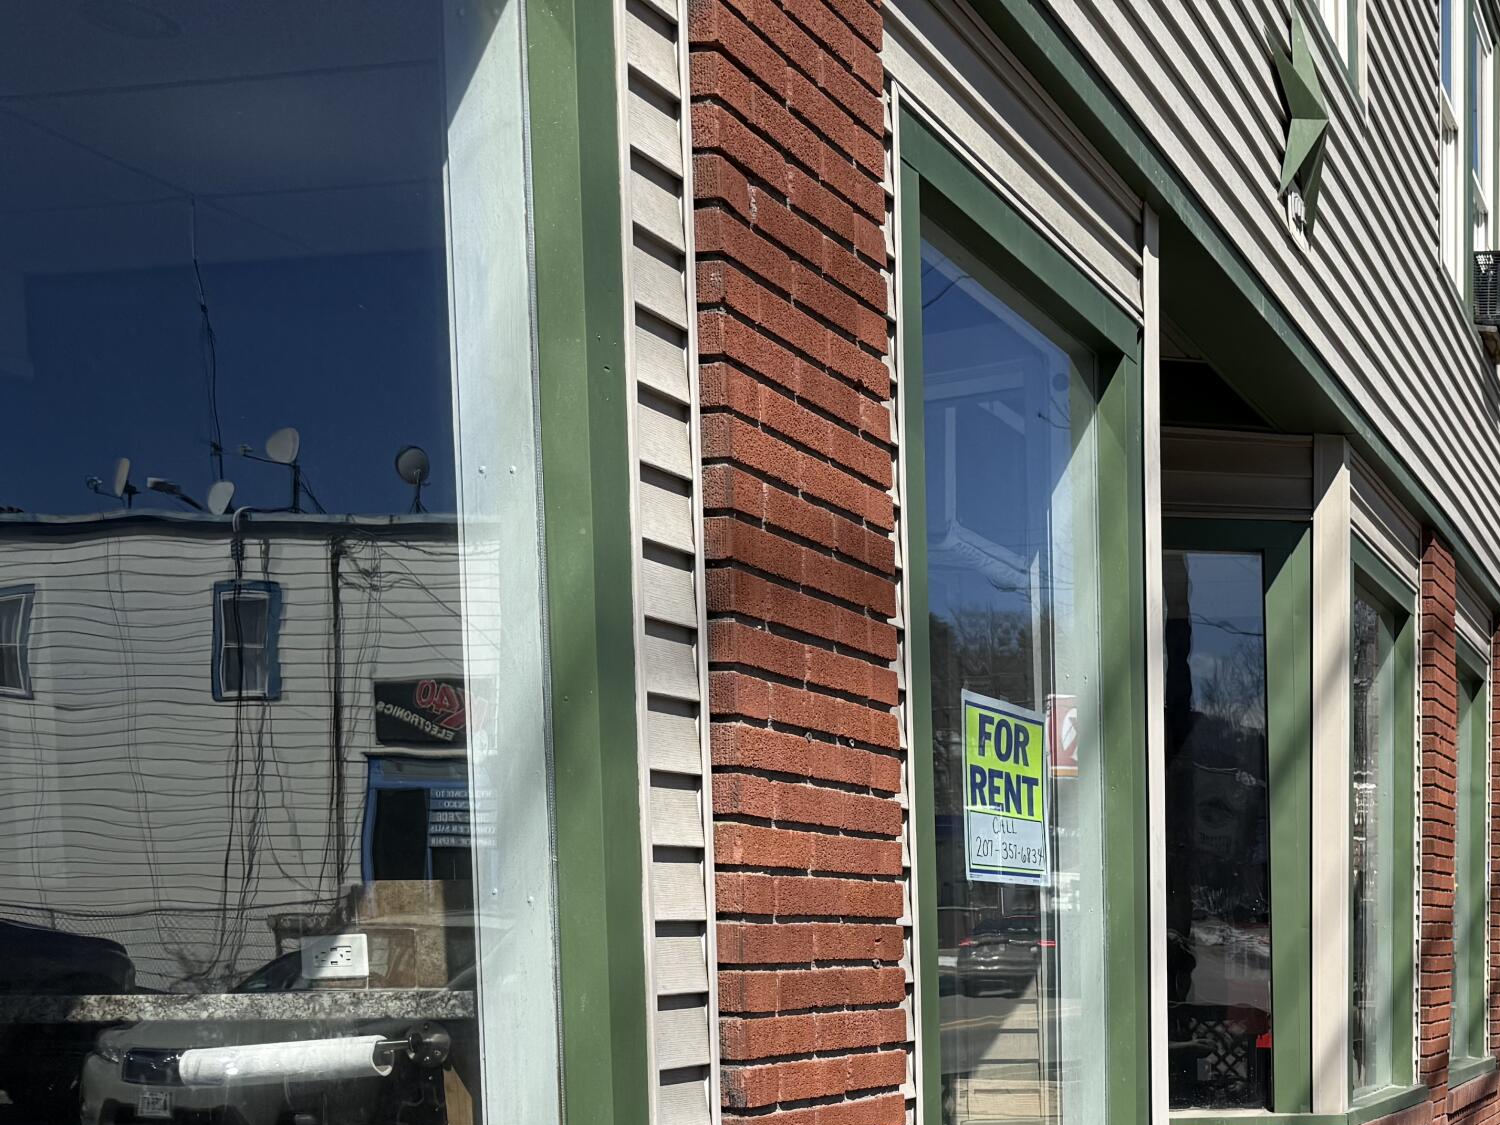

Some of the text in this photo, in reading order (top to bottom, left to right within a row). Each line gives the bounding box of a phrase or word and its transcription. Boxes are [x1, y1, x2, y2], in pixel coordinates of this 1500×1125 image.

[977, 712, 1030, 767] FOR
[969, 763, 1039, 817] RENT
[992, 816, 1017, 835] CALL
